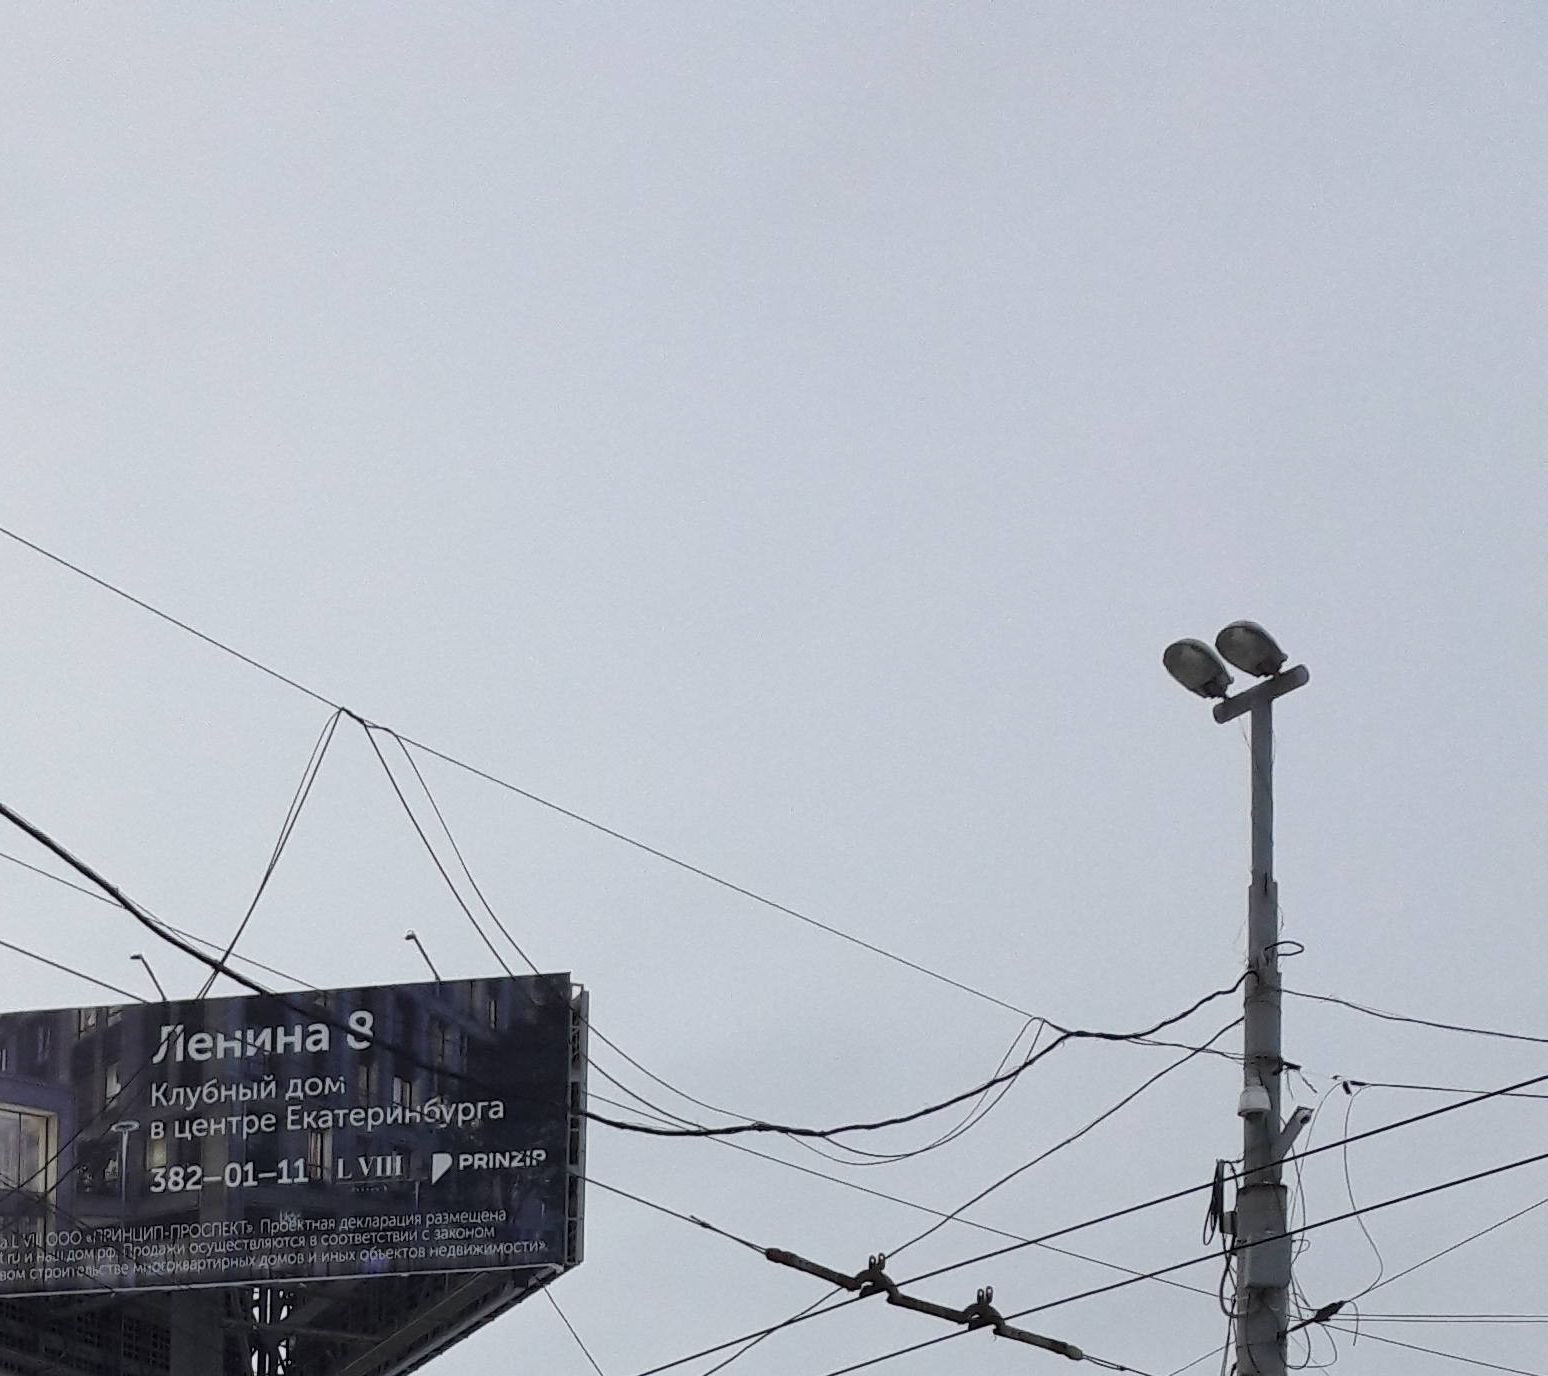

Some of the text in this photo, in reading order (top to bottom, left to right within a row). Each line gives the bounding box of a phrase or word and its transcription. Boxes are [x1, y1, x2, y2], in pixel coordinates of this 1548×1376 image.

[153, 1010, 374, 1063] Ленина 8
[152, 1075, 346, 1110] Клубный дом
[151, 1095, 505, 1141] в центре Екатеринбурга
[337, 1154, 404, 1179] L VIII
[47, 1231, 82, 1246] ООО
[260, 1218, 336, 1234] Проектная
[339, 1214, 422, 1231] декларация
[426, 1210, 507, 1227] размещена
[124, 1242, 185, 1259] Продажи
[189, 1234, 306, 1256] осуществляются
[309, 1236, 318, 1247] в
[320, 1230, 418, 1246] соответствии
[421, 1230, 430, 1241] с
[433, 1226, 495, 1240] законом
[29, 1263, 129, 1281] строительстве
[133, 1255, 256, 1275] многоквартирных
[258, 1253, 304, 1269] домов
[308, 1252, 317, 1264] и
[321, 1250, 356, 1264] иных
[359, 1246, 426, 1261] объектов
